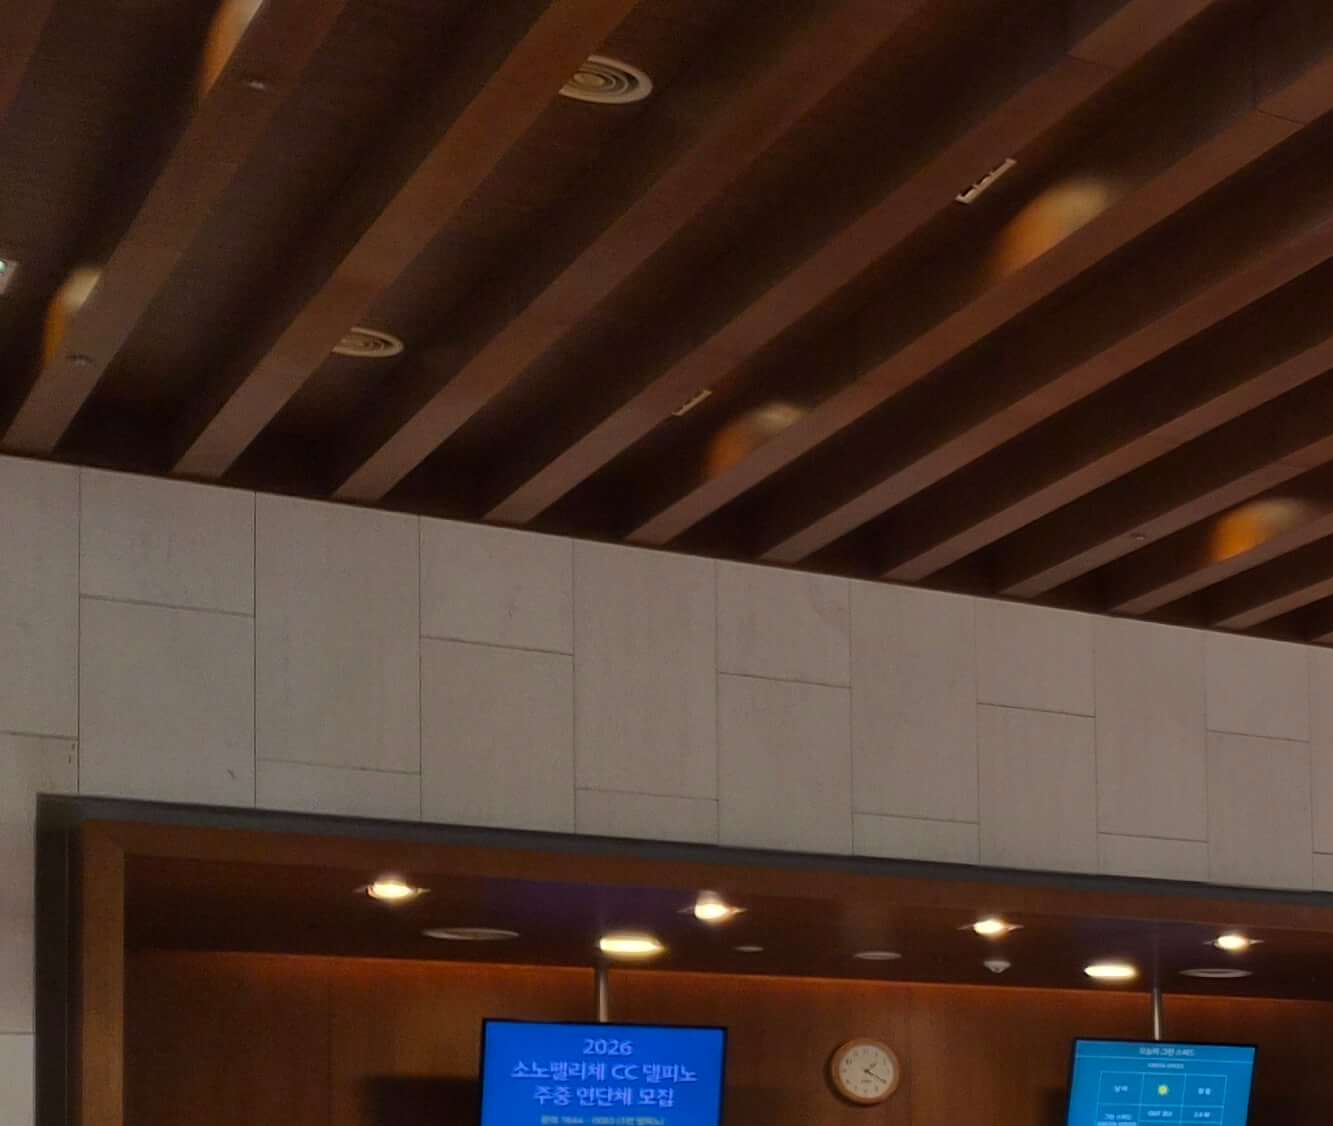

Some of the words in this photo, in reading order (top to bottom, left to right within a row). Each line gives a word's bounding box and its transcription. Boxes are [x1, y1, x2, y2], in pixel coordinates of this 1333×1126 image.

[583, 1039, 633, 1055] 2026
[611, 1064, 639, 1080] CC
[642, 1063, 697, 1083] 델피노
[533, 1085, 573, 1106] 주중
[639, 1088, 674, 1108] 모집
